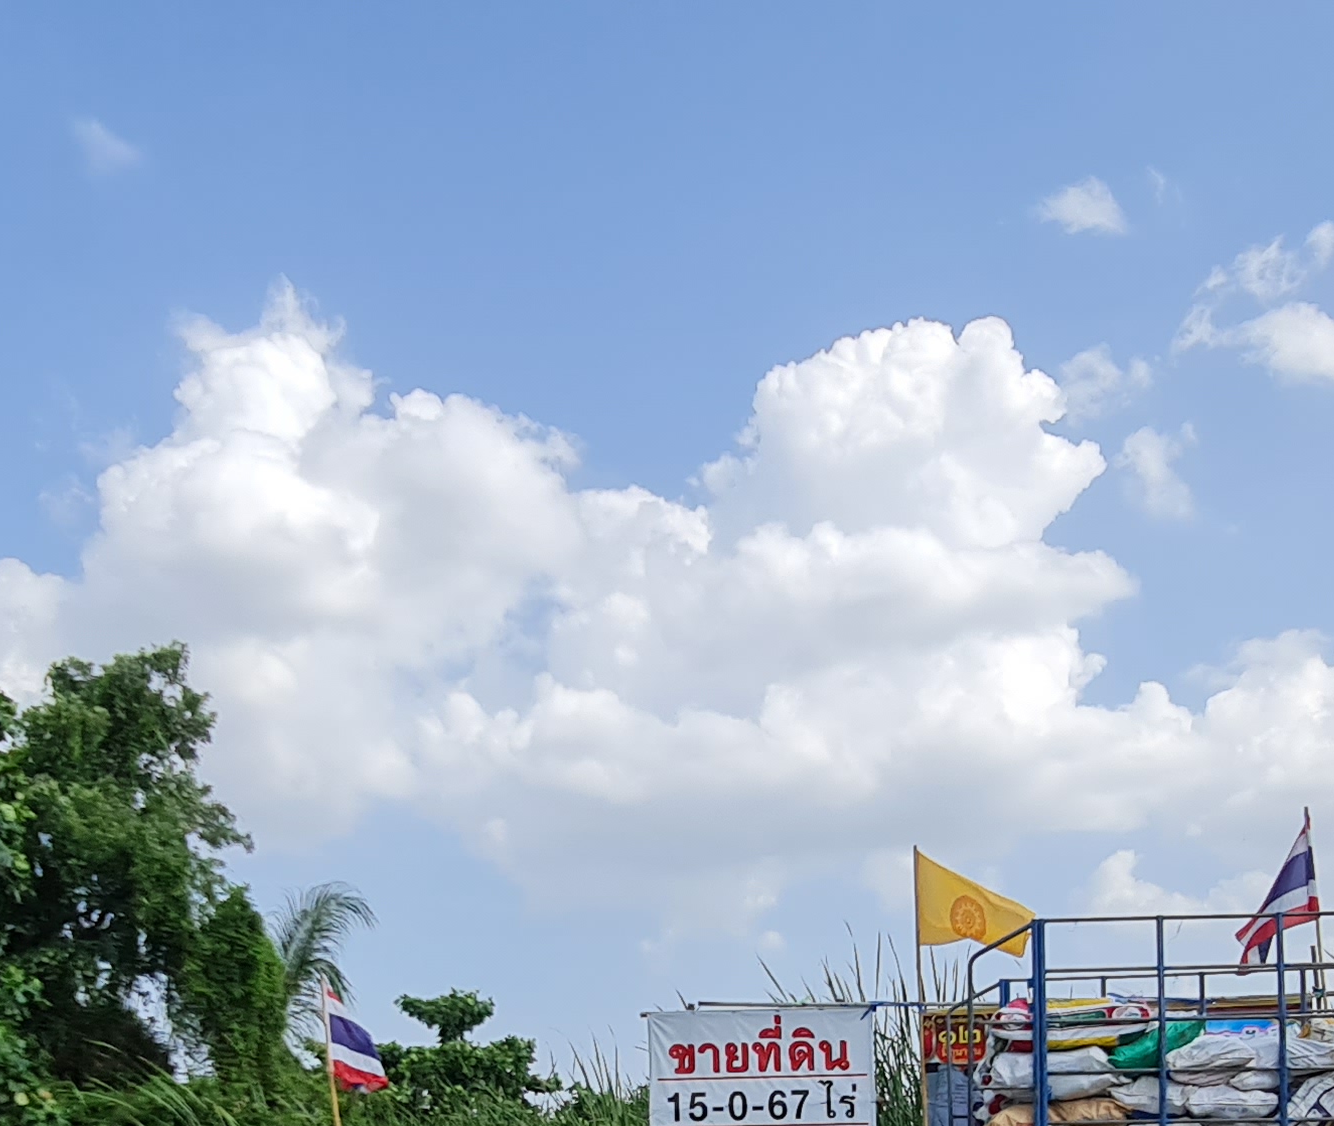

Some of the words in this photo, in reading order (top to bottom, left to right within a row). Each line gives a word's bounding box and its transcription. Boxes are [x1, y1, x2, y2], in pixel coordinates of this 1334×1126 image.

[668, 1014, 850, 1075] ขายที่ดิน
[667, 1090, 810, 1122] 15-0-67
[818, 1080, 857, 1119] ไร่
